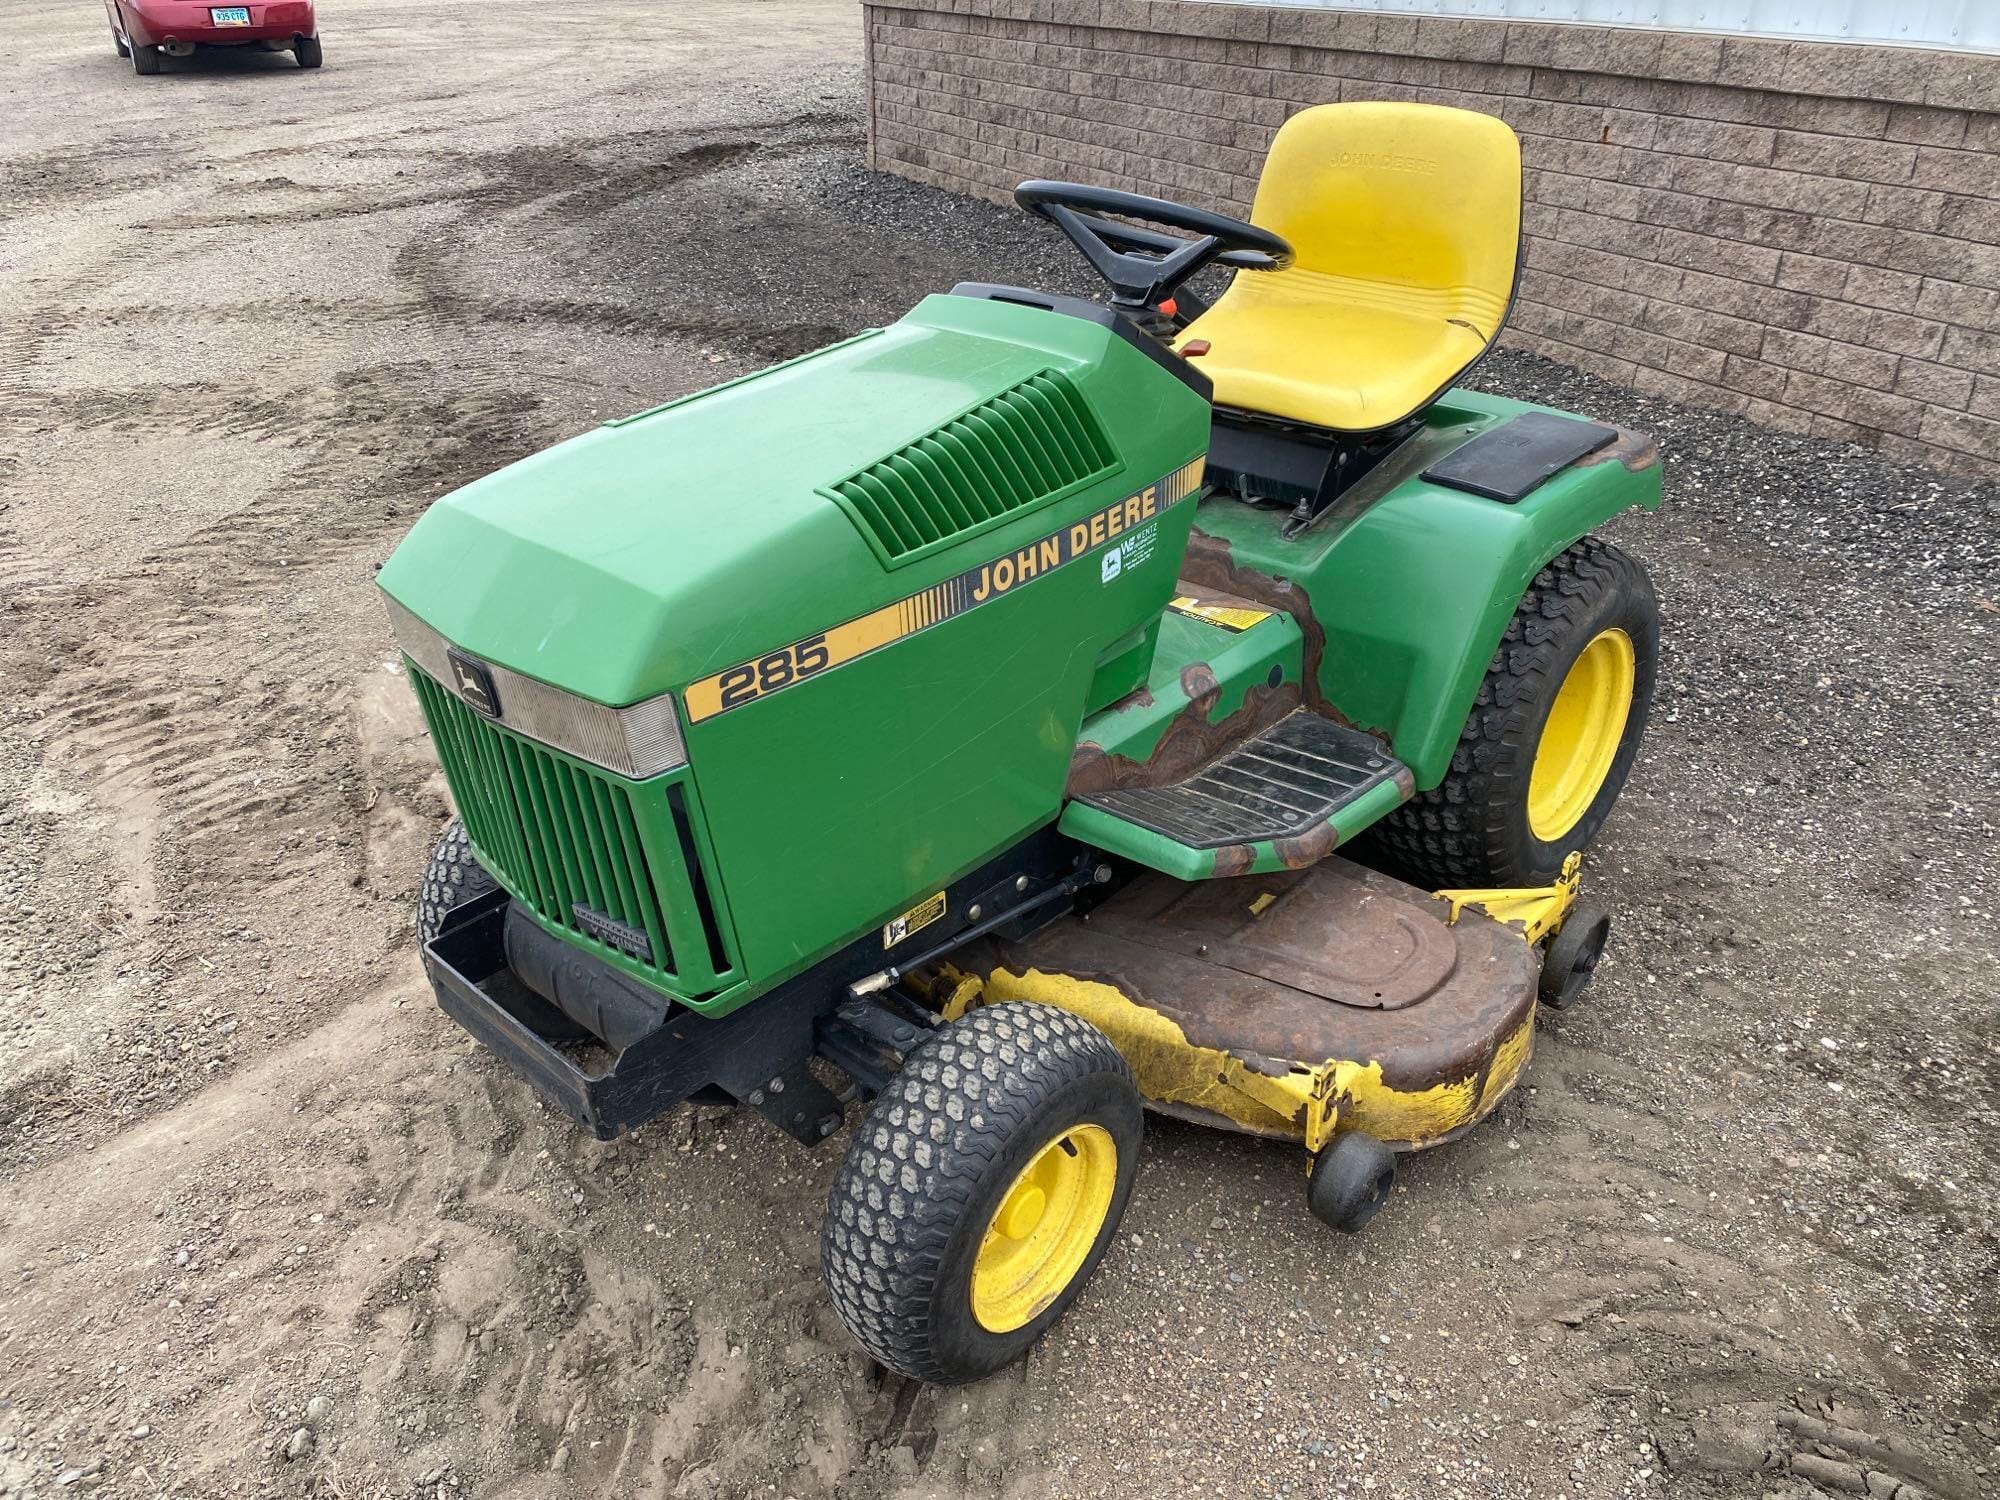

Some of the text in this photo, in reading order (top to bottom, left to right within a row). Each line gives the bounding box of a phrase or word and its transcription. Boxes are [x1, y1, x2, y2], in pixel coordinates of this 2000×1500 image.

[216, 12, 245, 21] 935 CTG
[1328, 152, 1376, 168] JOHN
[973, 486, 1156, 602] JOHN DEERE
[719, 635, 829, 709] 285
